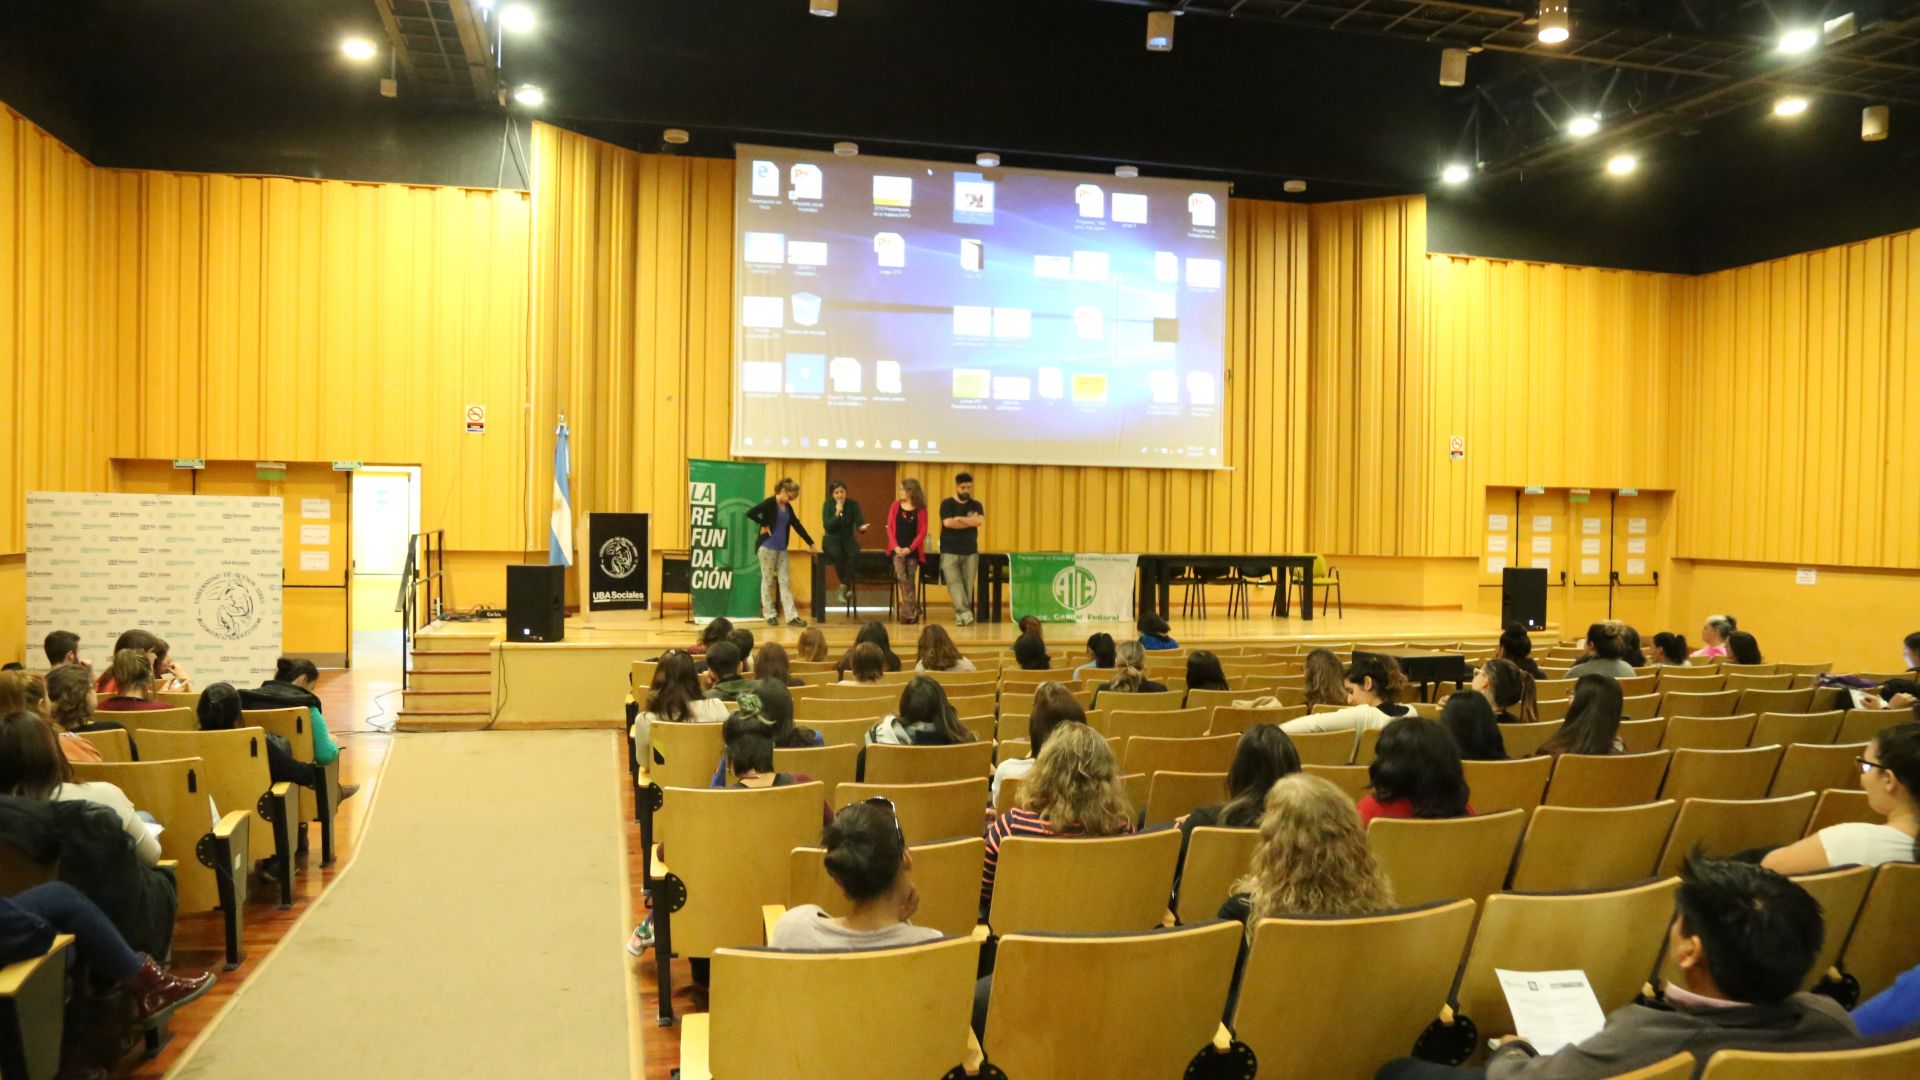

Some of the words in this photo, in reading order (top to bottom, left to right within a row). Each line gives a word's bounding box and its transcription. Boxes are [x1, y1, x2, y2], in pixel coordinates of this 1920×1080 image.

[691, 484, 712, 502] LA
[691, 506, 716, 526] RE
[691, 527, 727, 548] FUN
[691, 549, 714, 569] DA
[691, 566, 733, 590] CIÓN
[592, 591, 611, 600] UBA
[611, 590, 645, 599] Sociales
